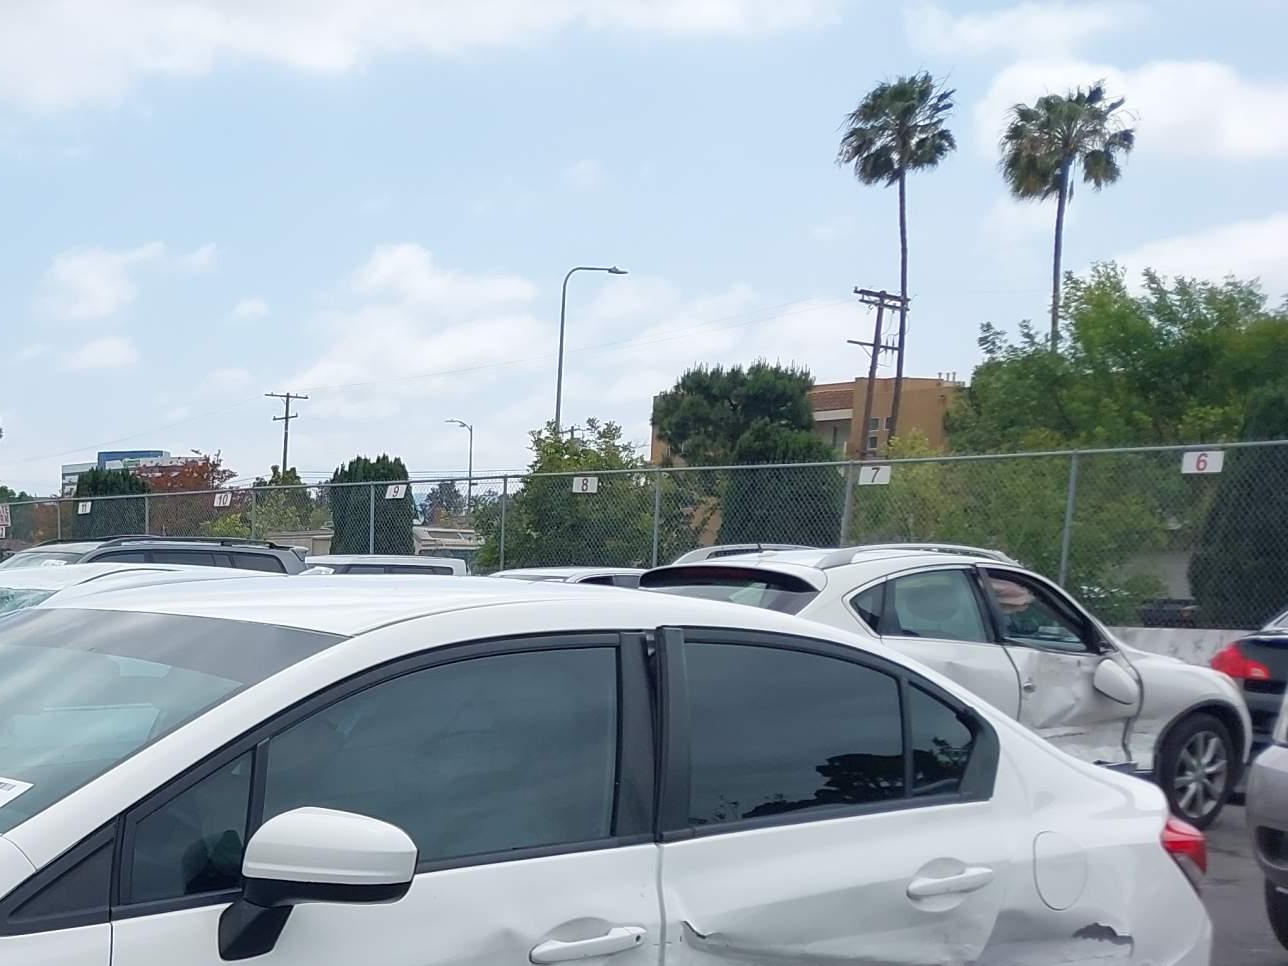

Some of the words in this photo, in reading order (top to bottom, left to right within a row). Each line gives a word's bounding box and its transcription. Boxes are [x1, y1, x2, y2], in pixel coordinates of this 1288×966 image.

[1195, 452, 1209, 472] 6
[871, 467, 881, 483] 7
[392, 485, 400, 498] 9
[581, 478, 589, 492] 8
[218, 494, 229, 506] 10
